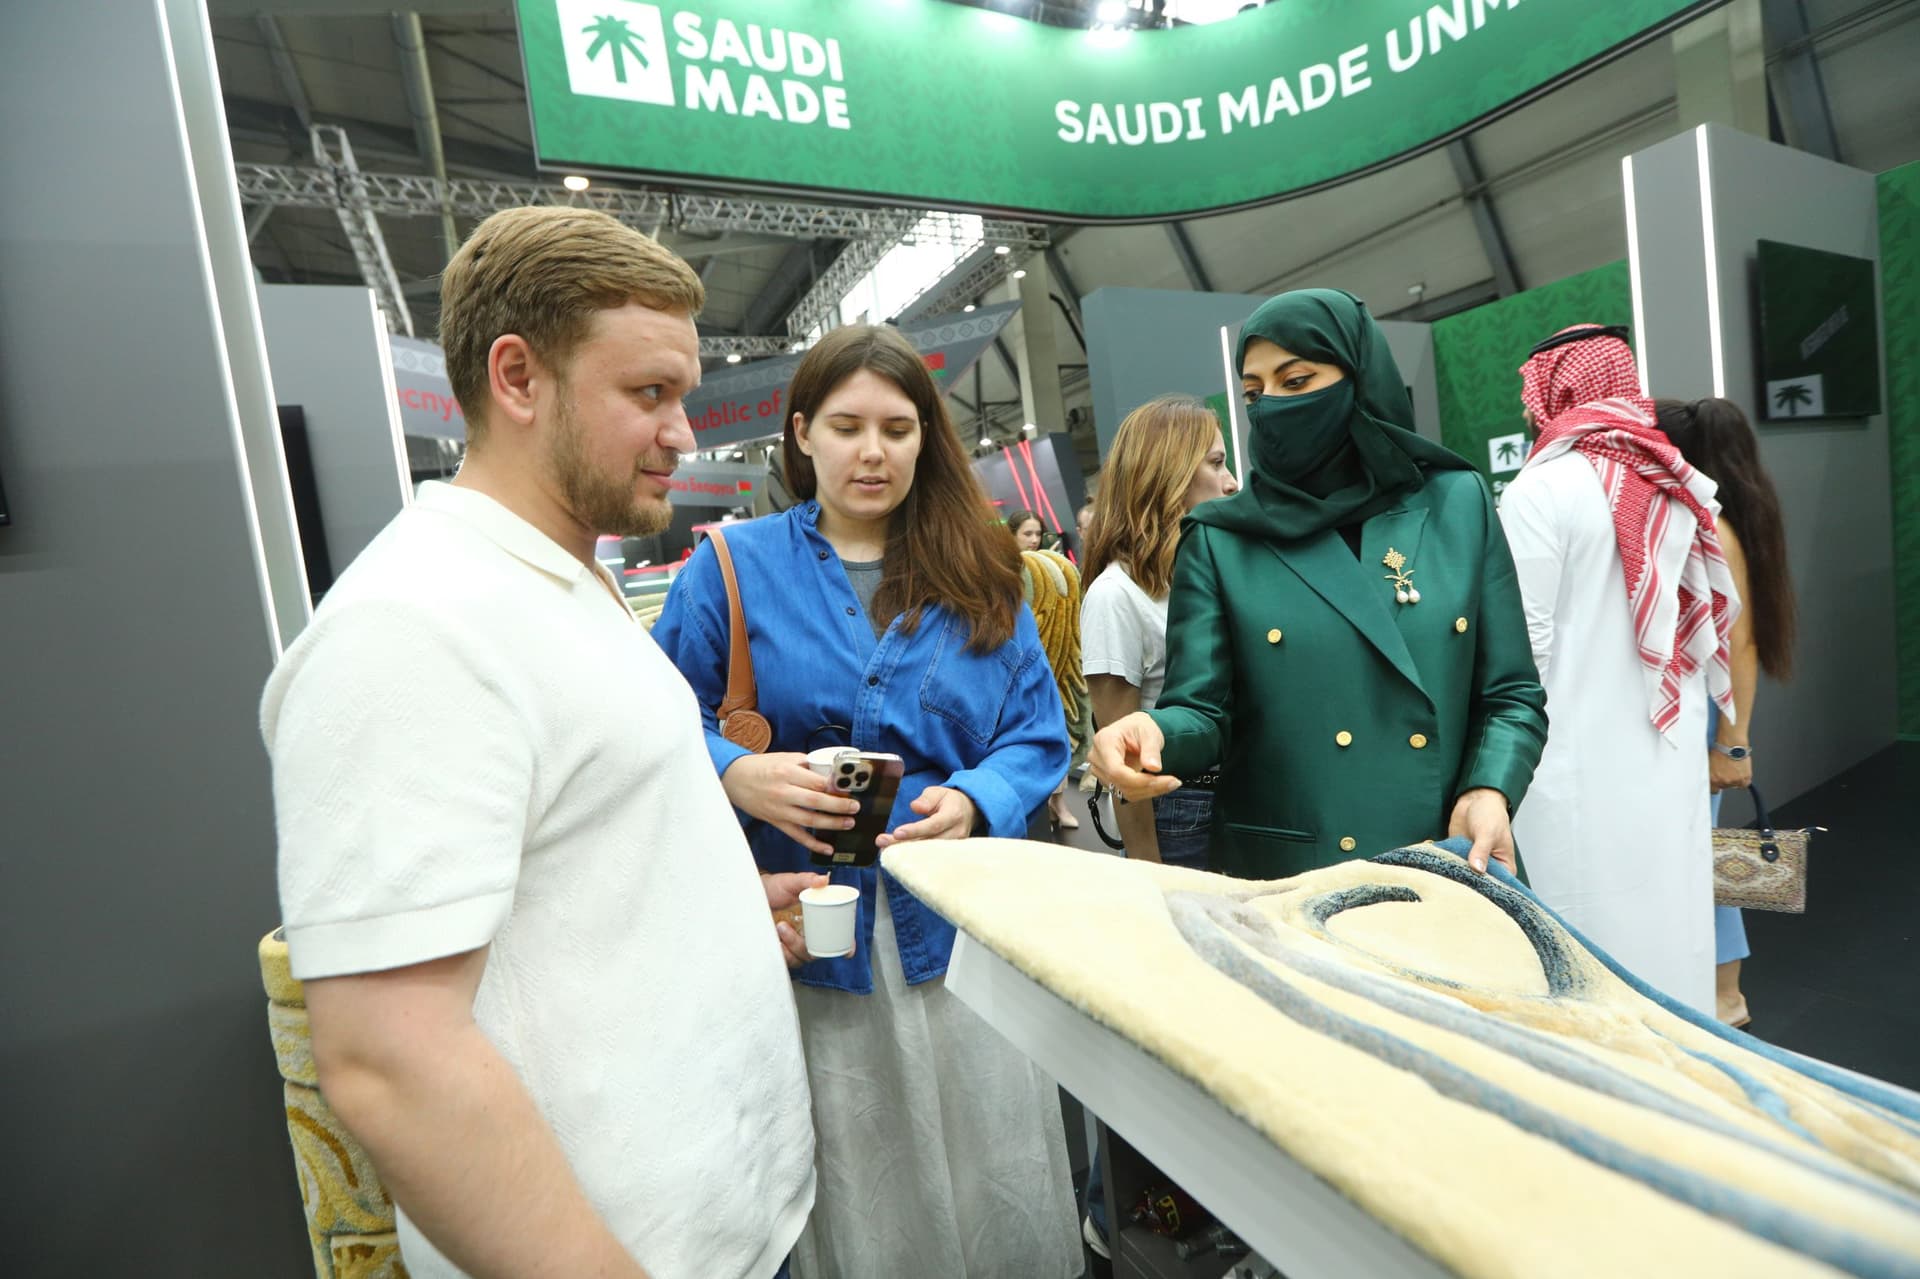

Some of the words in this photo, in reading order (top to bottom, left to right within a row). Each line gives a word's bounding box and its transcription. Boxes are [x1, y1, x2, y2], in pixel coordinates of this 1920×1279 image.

[673, 10, 844, 82] SAUDI
[685, 64, 851, 130] MADE
[1055, 97, 1206, 146] SAUDI
[1218, 43, 1372, 134] MADE
[757, 388, 783, 418] of
